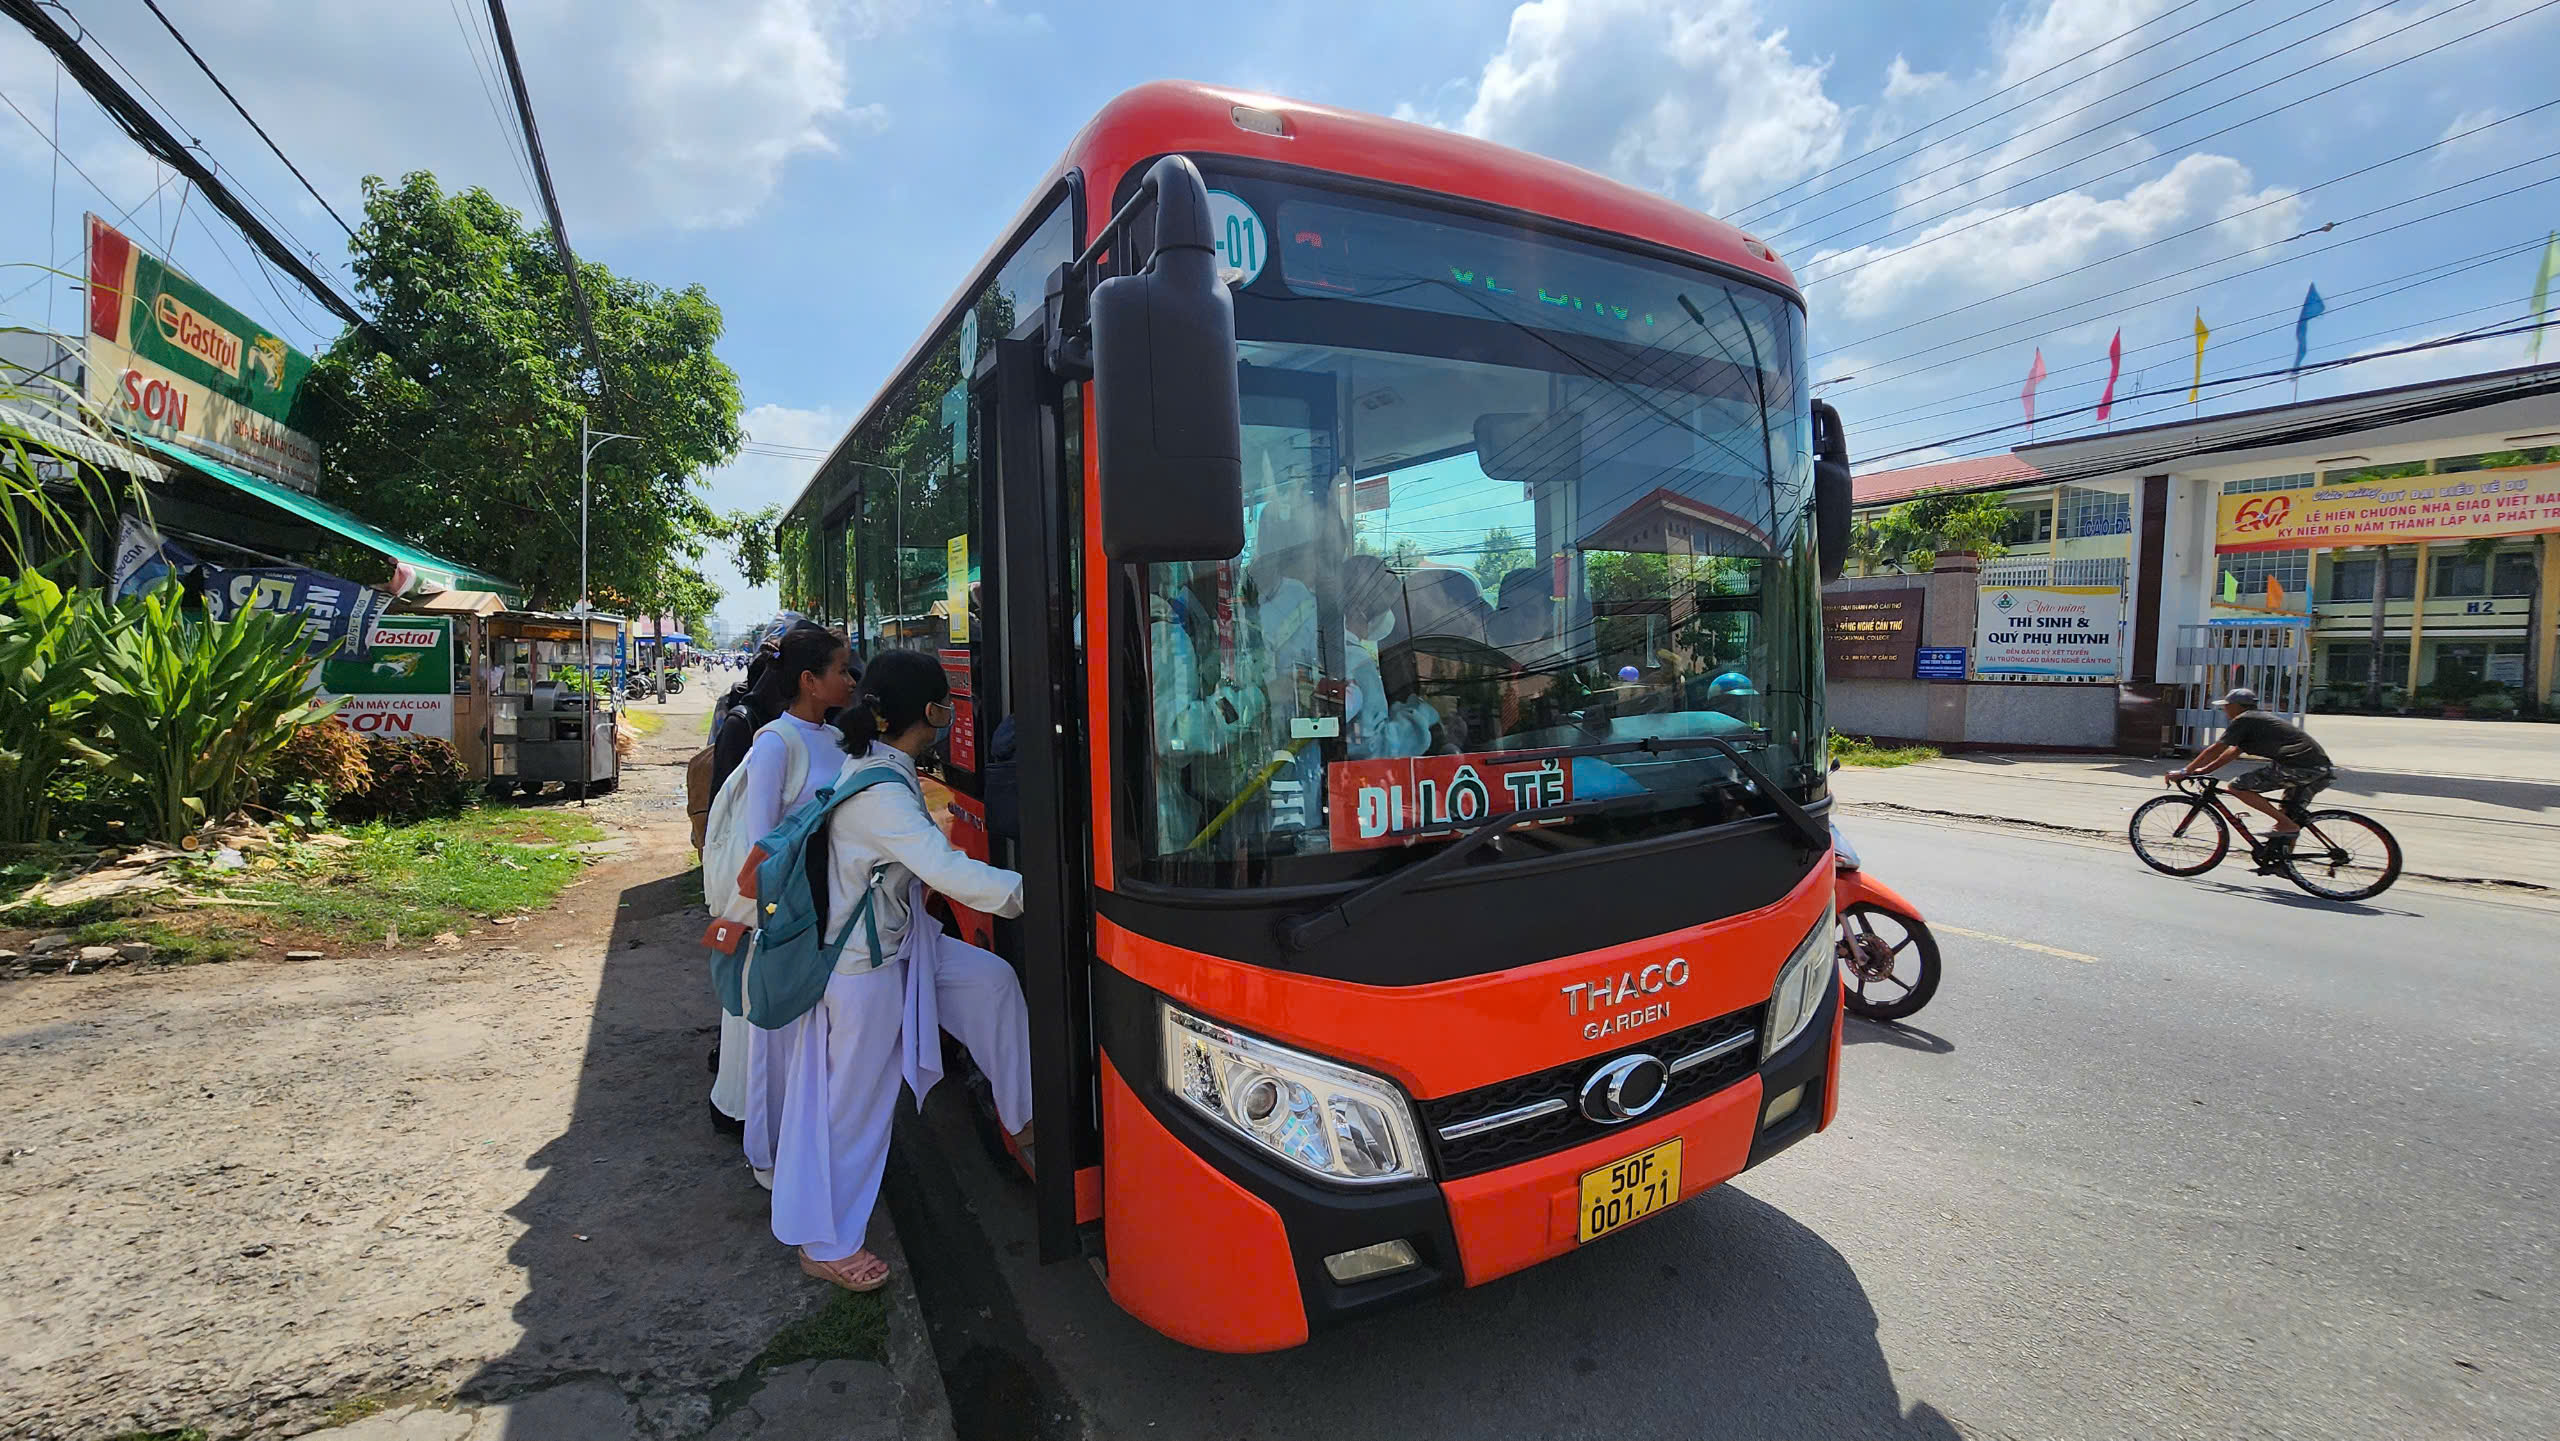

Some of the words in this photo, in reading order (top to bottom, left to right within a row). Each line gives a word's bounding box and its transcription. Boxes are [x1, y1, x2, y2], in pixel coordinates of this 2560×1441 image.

[180, 311, 237, 371] Castrol
[122, 369, 188, 431] SƠN
[2084, 518, 2110, 537] CAO
[2333, 524, 2349, 534] 60
[2026, 599, 2055, 613] Chào
[2008, 614, 2033, 628] THÍ
[2036, 616, 2072, 628] SINH
[2076, 616, 2090, 628] &
[375, 630, 434, 645] Castrol
[1988, 630, 2019, 645] QUÝ
[2022, 632, 2052, 647] PHỤ
[2057, 633, 2109, 645] HUYNH
[366, 697, 389, 710] MÁY
[392, 698, 414, 710] CÁC
[416, 700, 441, 712] LOẠI
[334, 712, 414, 733] SƠN
[1357, 785, 1404, 839] ĐI
[1419, 764, 1490, 838] LÔ
[1504, 757, 1567, 827] TẺ
[1560, 957, 1689, 1017] THACO
[1583, 1001, 1671, 1041] GARDEN
[1611, 1152, 1655, 1195] 50F
[1590, 1176, 1668, 1235] 001.71
